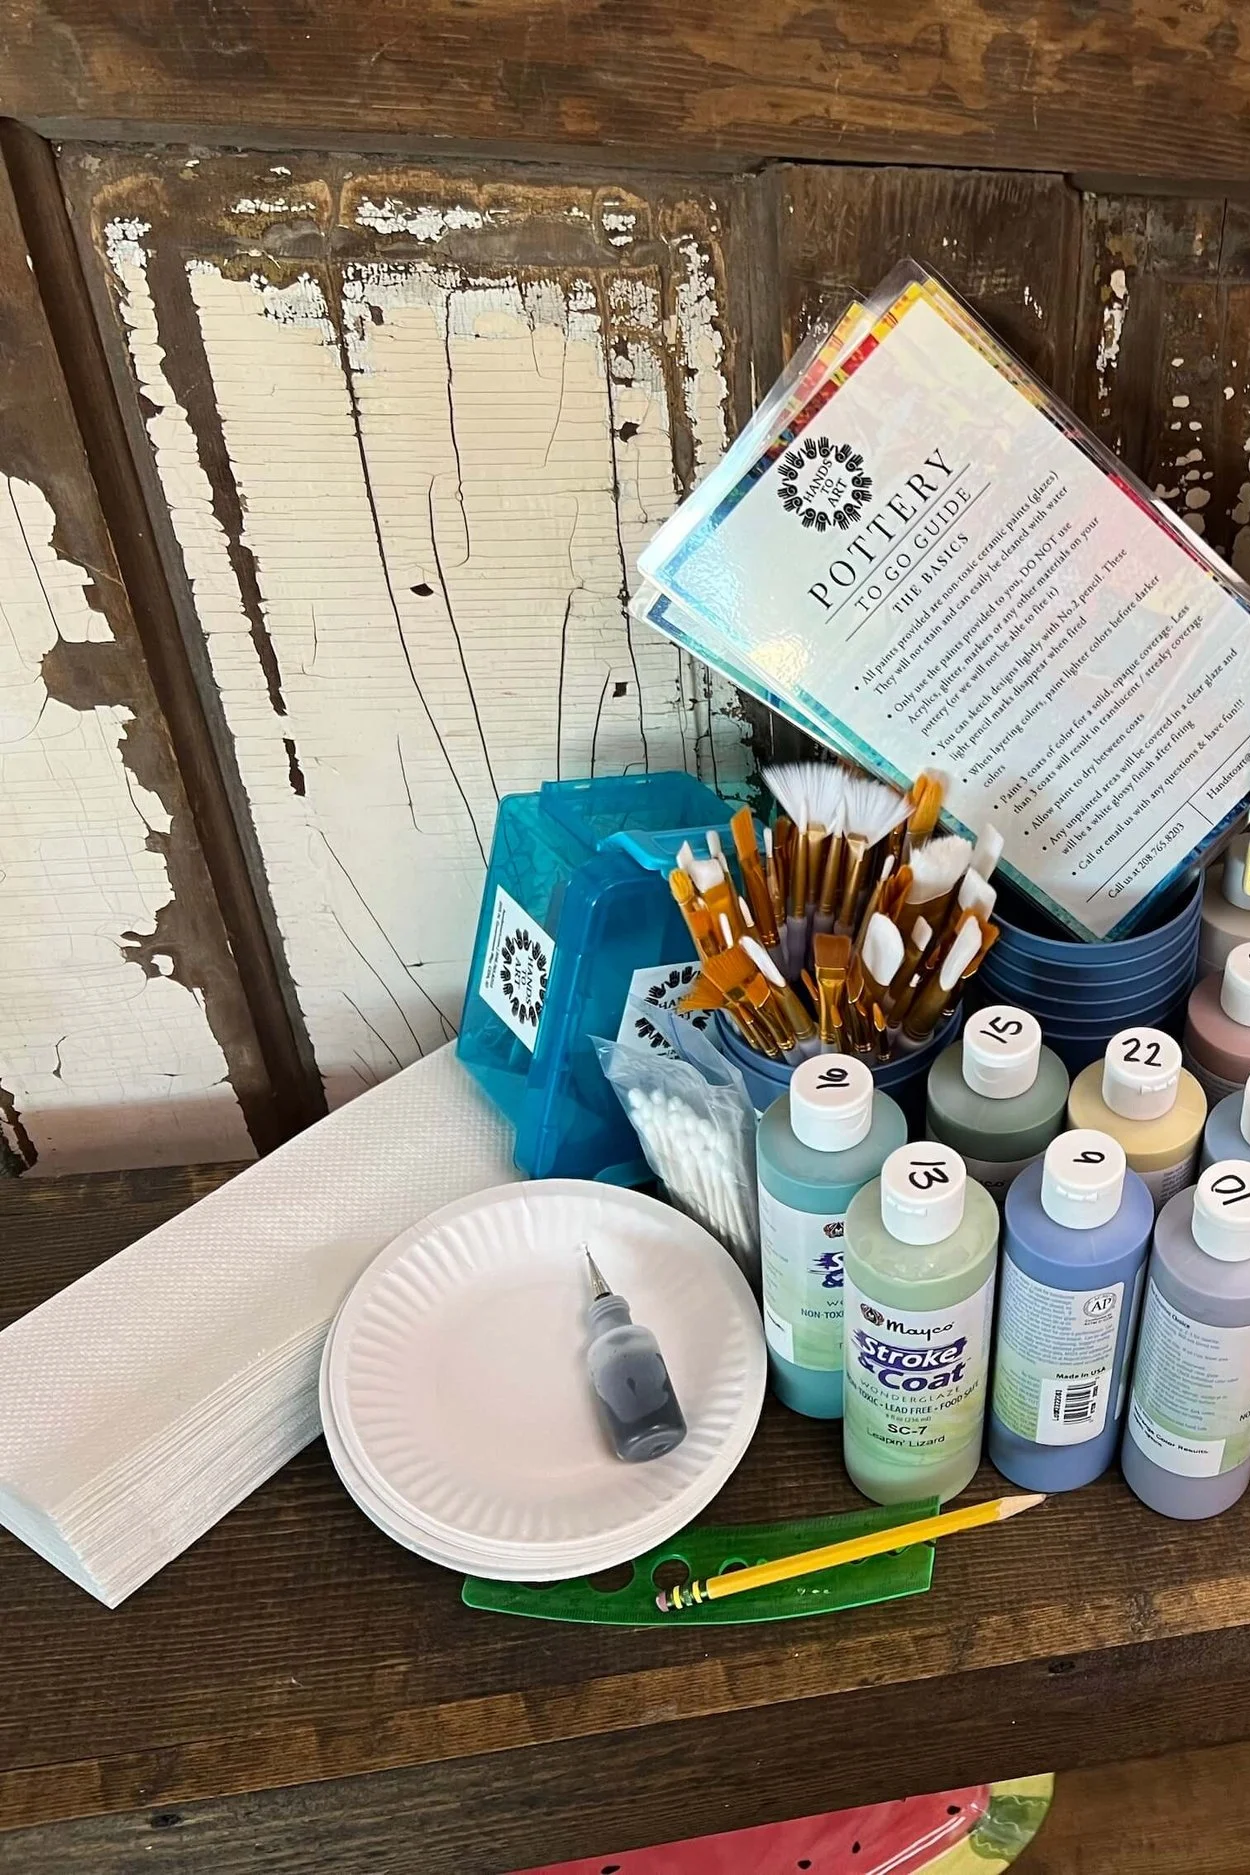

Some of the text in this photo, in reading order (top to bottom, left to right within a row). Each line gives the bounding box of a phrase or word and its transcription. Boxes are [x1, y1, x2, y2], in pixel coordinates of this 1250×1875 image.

[803, 458, 832, 503] HANDS
[820, 479, 834, 494] TO
[828, 478, 847, 507] ART
[807, 448, 953, 610] POTTERY
[854, 487, 971, 612] TO GO GUIDE
[892, 535, 969, 614] THE BASICS
[862, 669, 877, 685] All
[874, 647, 899, 675] paints
[897, 609, 931, 650] provided
[930, 599, 943, 613] are
[977, 528, 1007, 561] ceramic
[1005, 503, 1031, 532] paints
[936, 733, 956, 750] You
[954, 719, 970, 734] can
[968, 695, 993, 720] sketch
[990, 667, 1019, 696] designs
[1014, 641, 1043, 668] lightly
[1041, 622, 1060, 641] with
[1101, 549, 1127, 573] These
[968, 754, 993, 776] When
[989, 724, 1024, 755] layering
[1044, 677, 1066, 702] paint
[1062, 651, 1090, 679] lighter
[1089, 627, 1113, 653] colors
[1108, 601, 1137, 629] before
[1134, 575, 1160, 602] darker
[1031, 806, 1054, 830] Allow
[1053, 787, 1075, 810] paint
[1081, 764, 1097, 779] dry
[1092, 733, 1126, 766] between
[1125, 713, 1145, 734] coats
[1078, 852, 1097, 870] Call
[1104, 823, 1125, 846] email
[1132, 799, 1151, 816] with
[1150, 784, 1165, 800] any
[1163, 749, 1199, 785] questions
[1203, 722, 1224, 742] have
[1108, 881, 1125, 899] Call
[979, 1016, 1023, 1044] 15
[1121, 1037, 1163, 1068] 22
[800, 1308, 844, 1319] NON-TOXI
[864, 1337, 958, 1368] Stroke
[877, 1361, 967, 1391] Coat
[1091, 1366, 1106, 1376] USA
[885, 1403, 908, 1414] LEAD
[910, 1406, 932, 1415] FREE
[940, 1394, 963, 1411] FOOD
[887, 1423, 928, 1435] SC-7
[908, 1435, 946, 1448] Lizard
